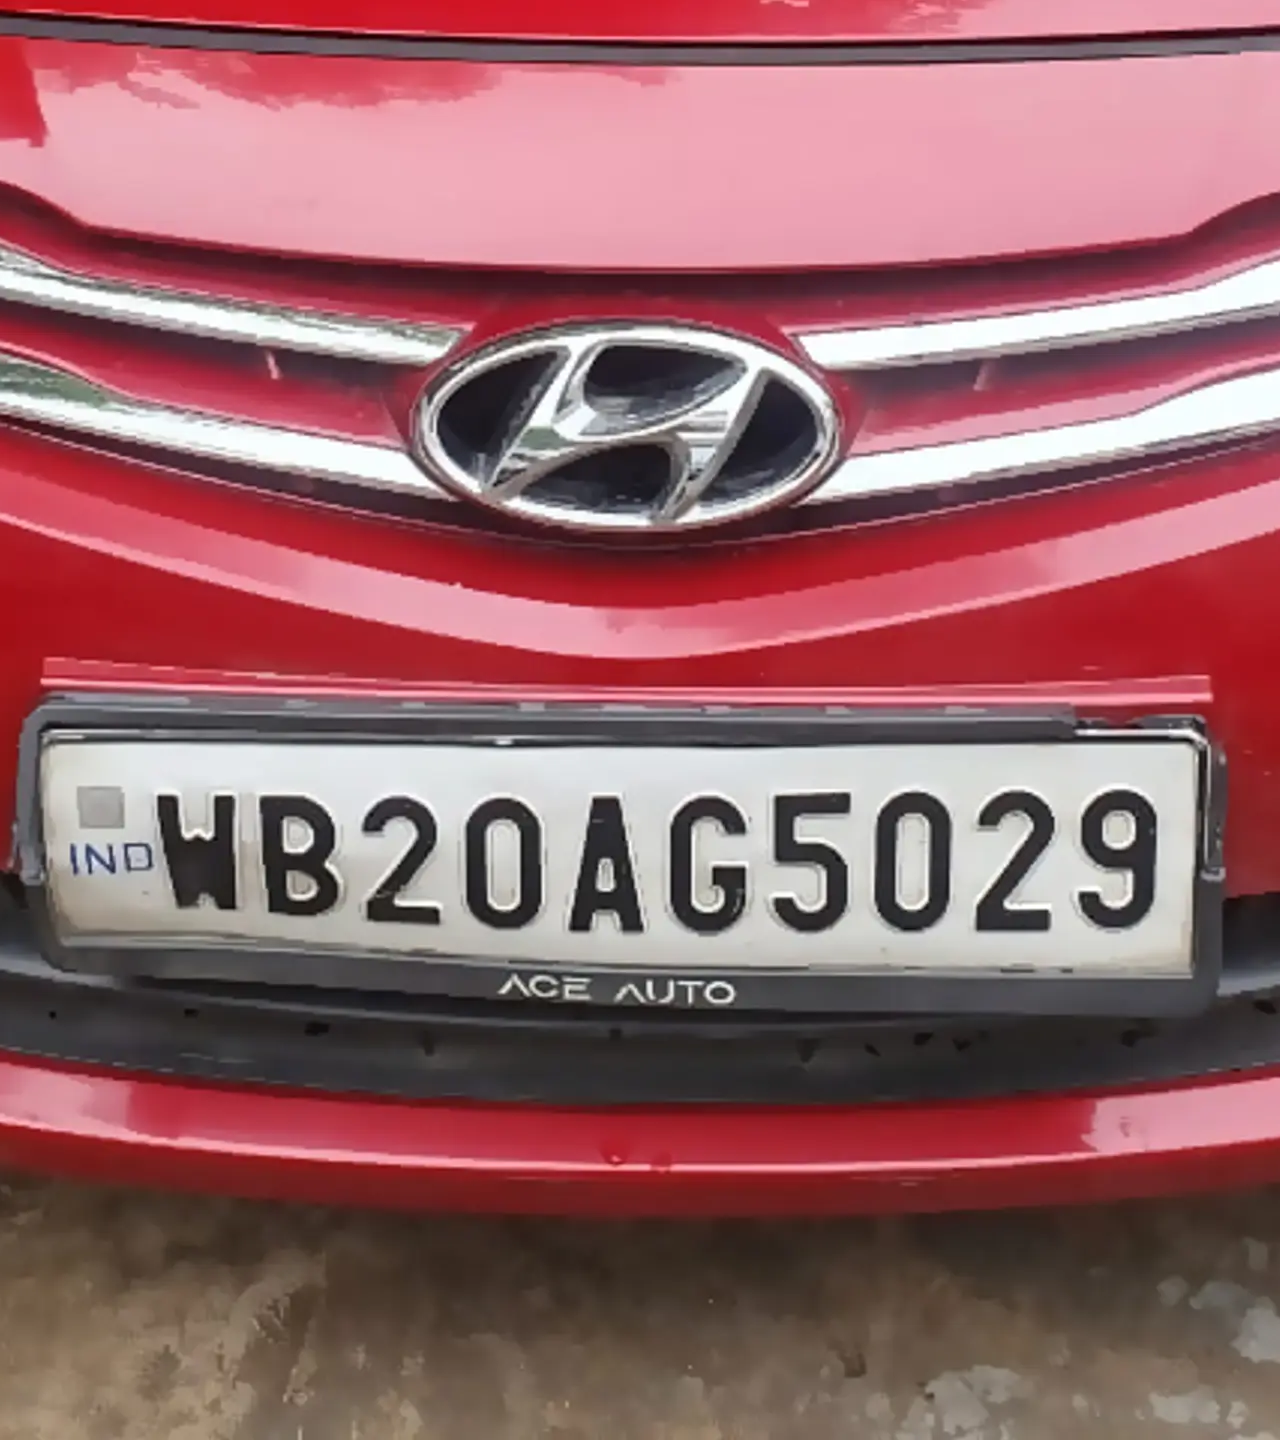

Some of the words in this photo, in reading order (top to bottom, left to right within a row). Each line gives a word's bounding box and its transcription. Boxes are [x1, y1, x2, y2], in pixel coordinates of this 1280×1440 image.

[69, 842, 154, 875] IND
[157, 789, 1158, 932] WB20AG5029
[497, 973, 593, 1001] ACE
[613, 978, 737, 1005] AUTO
